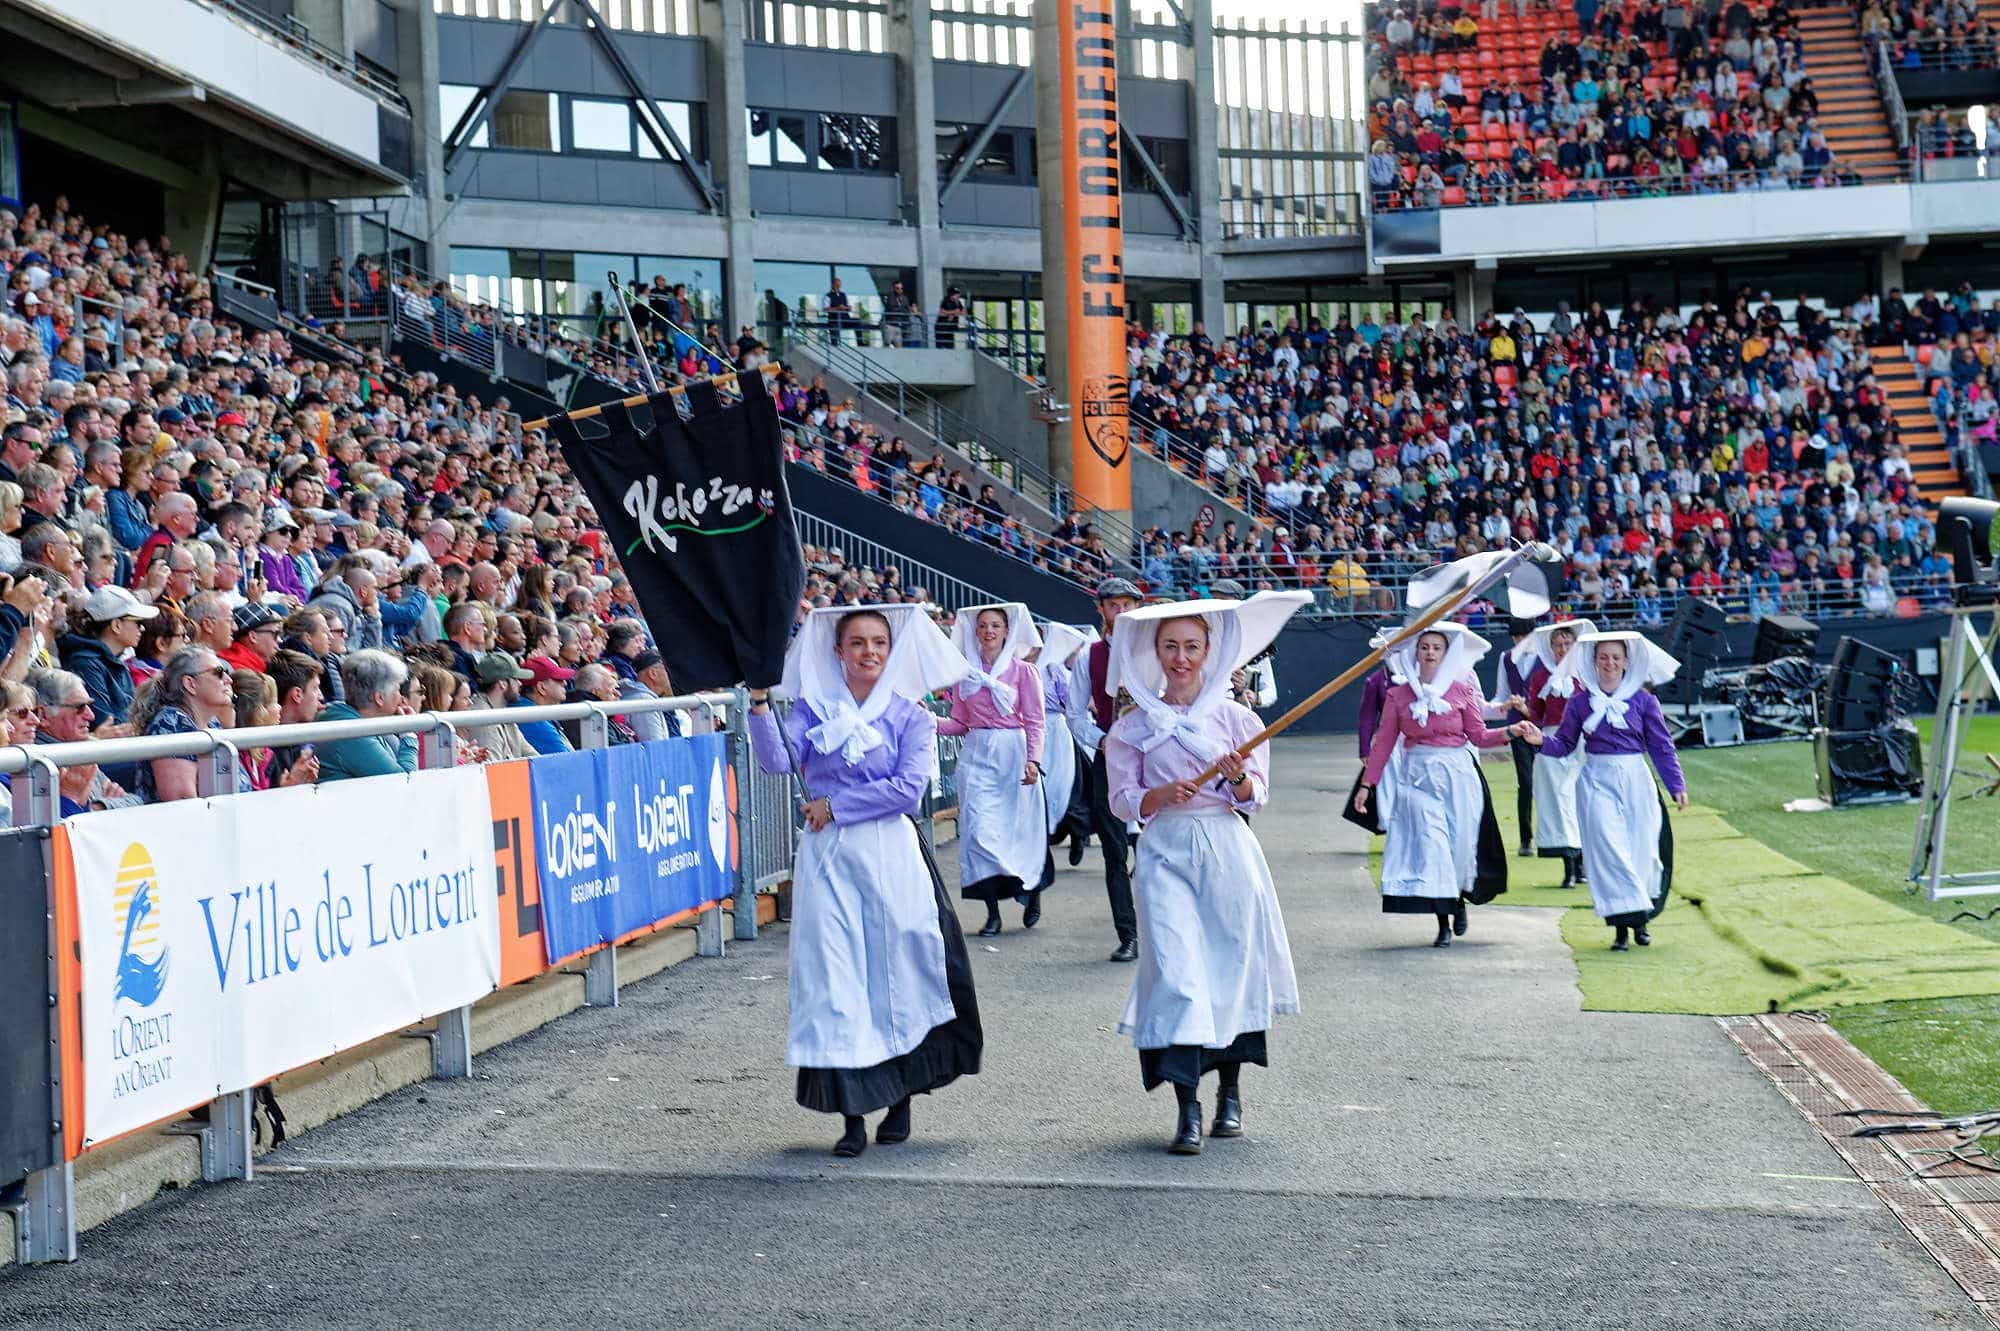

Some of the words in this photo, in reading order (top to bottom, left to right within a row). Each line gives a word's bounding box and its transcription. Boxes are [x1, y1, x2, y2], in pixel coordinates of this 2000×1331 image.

[1074, 4, 1121, 228] LORIENT
[1083, 253, 1124, 317] FC
[1084, 403, 1097, 416] FC
[196, 878, 302, 994] Ville
[315, 867, 353, 963] de
[361, 848, 477, 948] Lorient
[112, 1012, 173, 1061] LORIENT
